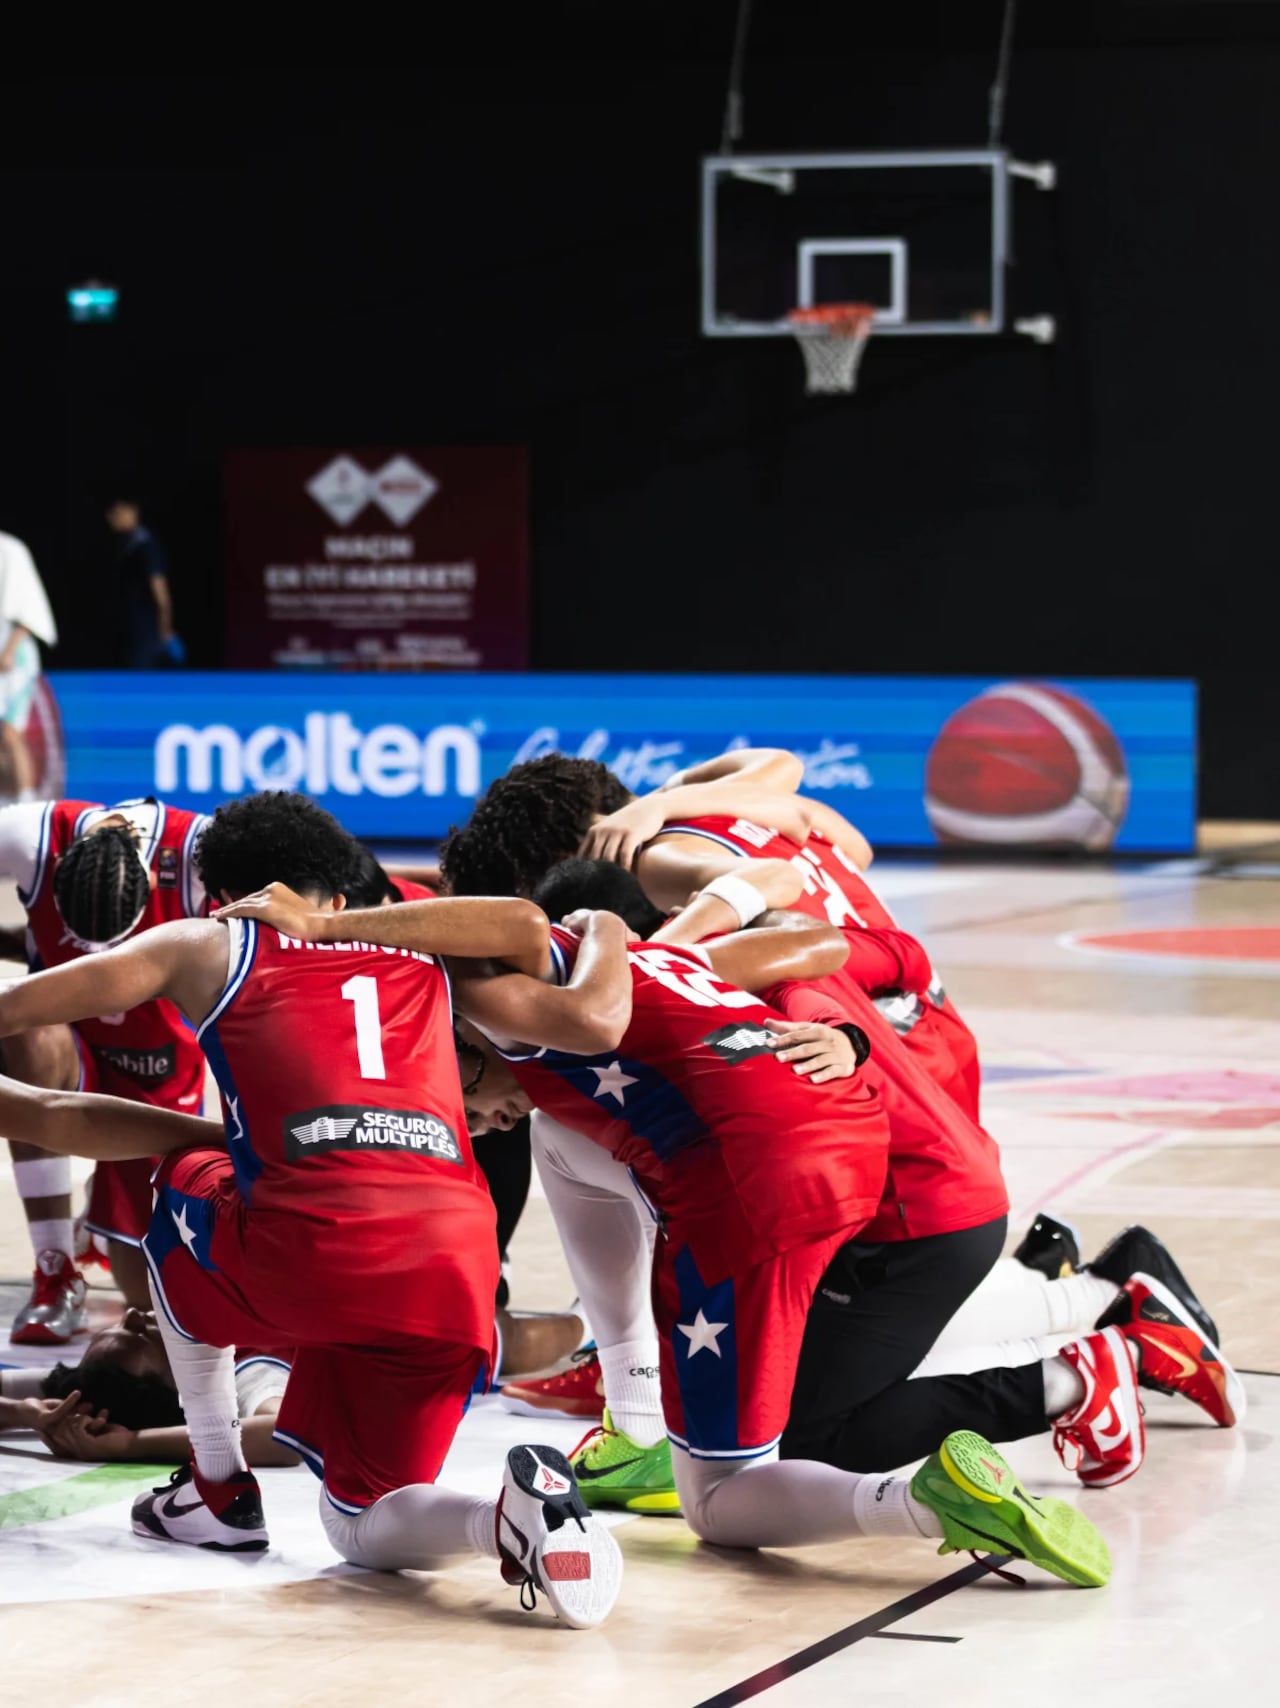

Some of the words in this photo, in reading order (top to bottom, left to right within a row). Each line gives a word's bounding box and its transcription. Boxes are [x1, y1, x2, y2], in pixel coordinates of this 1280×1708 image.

[154, 711, 481, 798] molten
[340, 974, 387, 1081] 1
[355, 1126, 458, 1159] MULTIPLES
[362, 1111, 450, 1142] SEGUROS
